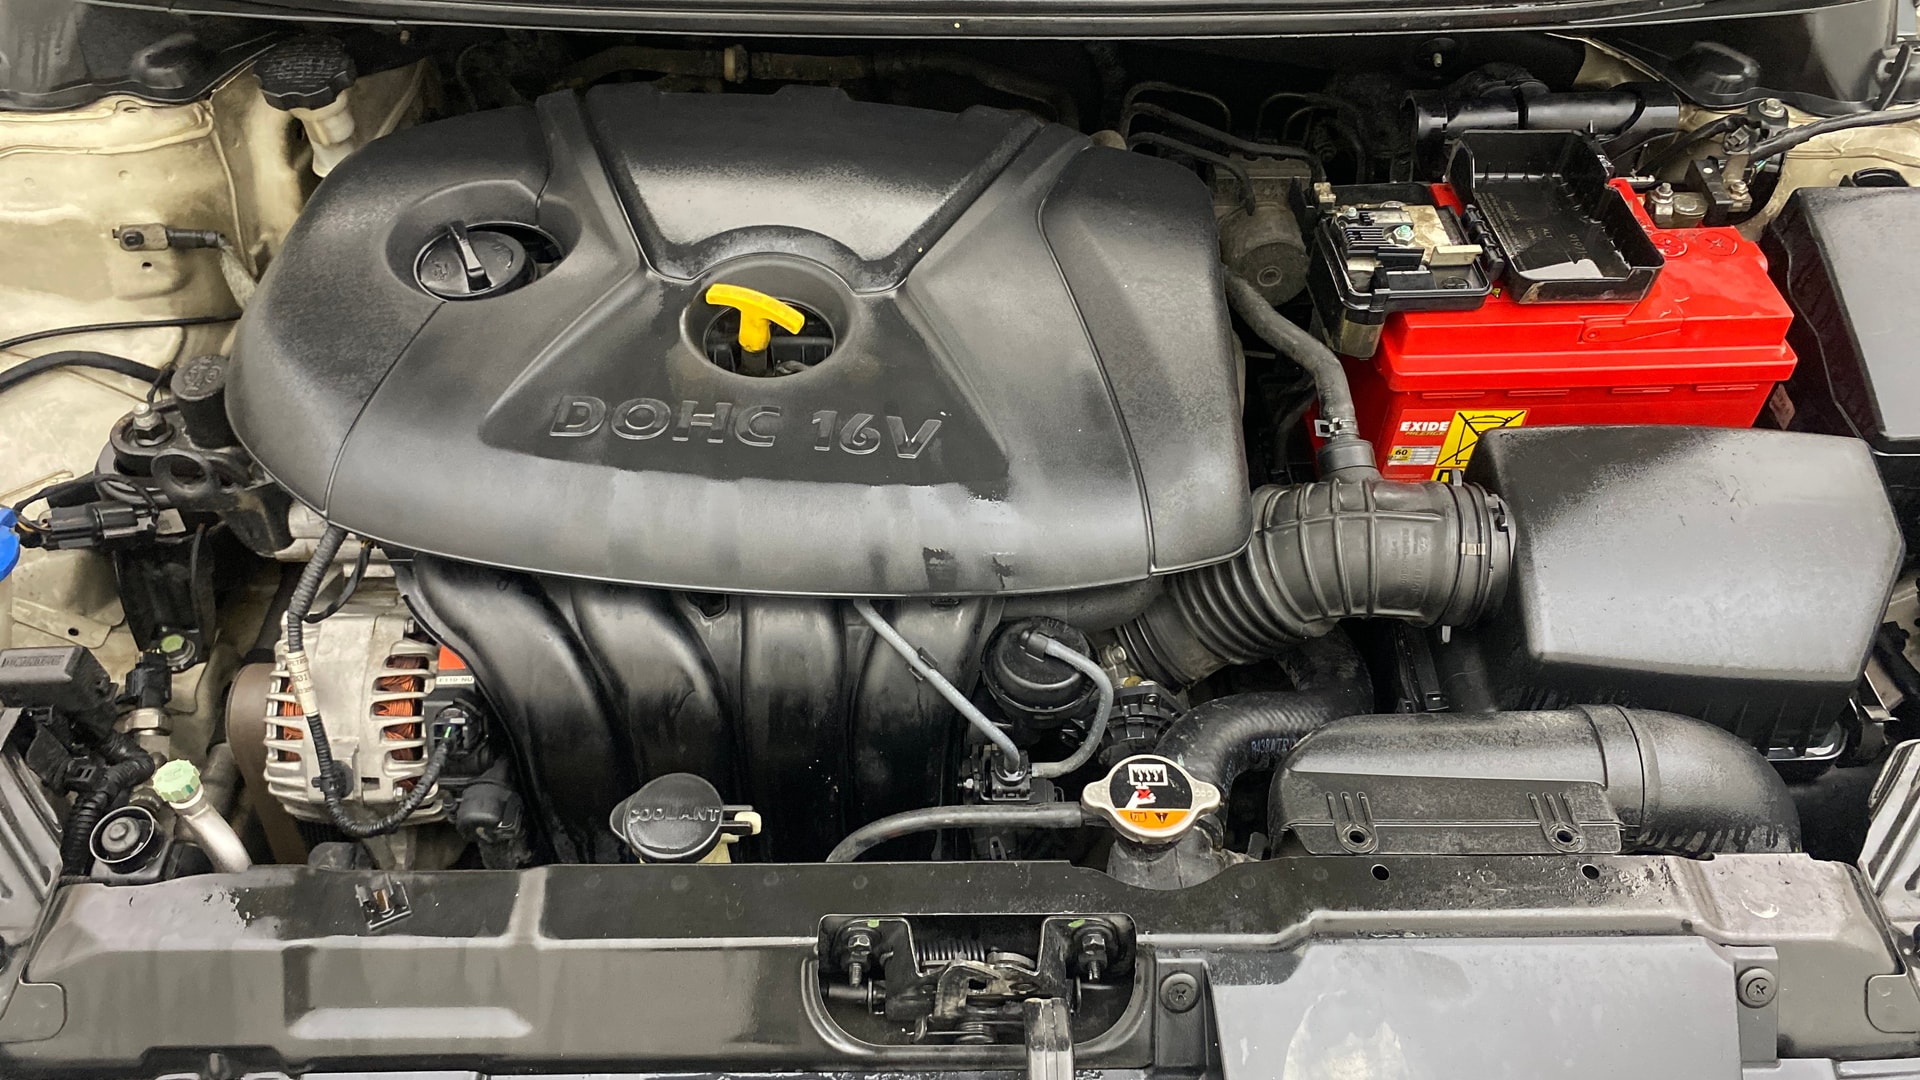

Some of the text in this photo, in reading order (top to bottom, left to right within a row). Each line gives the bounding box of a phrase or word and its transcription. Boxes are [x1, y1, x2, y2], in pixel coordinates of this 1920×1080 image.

[549, 395, 941, 459] DOHC 16V
[1400, 421, 1450, 431] EXIDE
[629, 807, 720, 824] COOLANT
